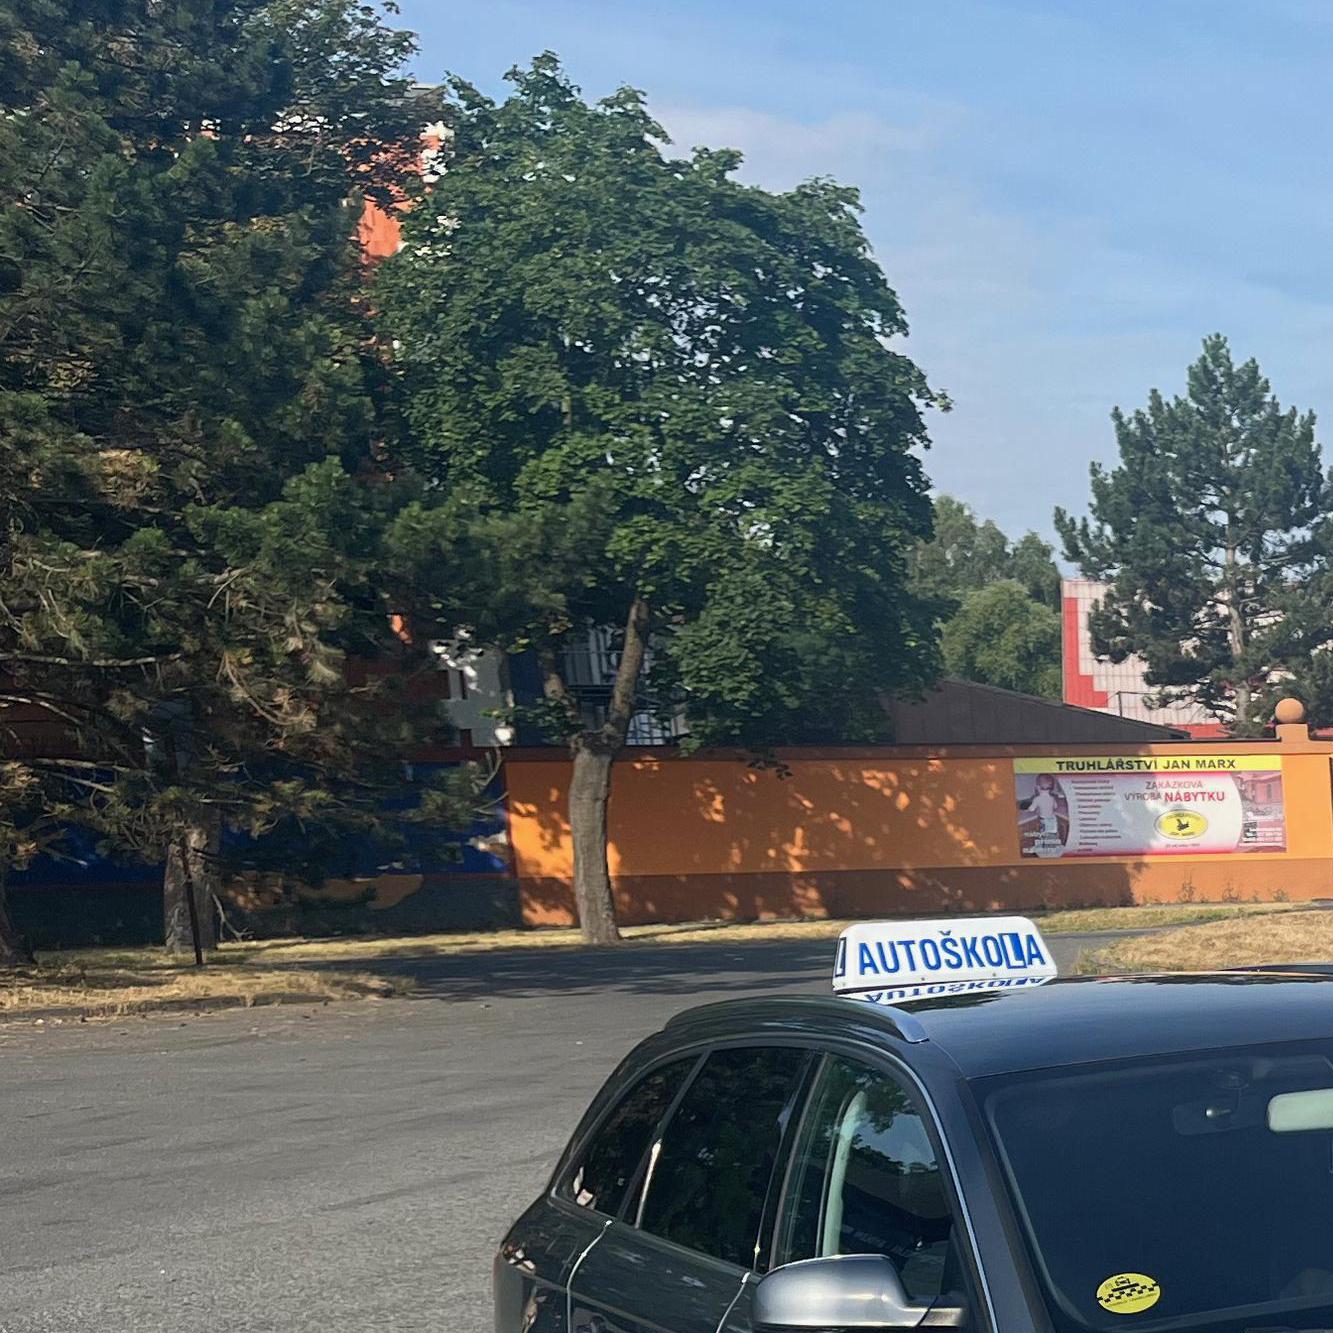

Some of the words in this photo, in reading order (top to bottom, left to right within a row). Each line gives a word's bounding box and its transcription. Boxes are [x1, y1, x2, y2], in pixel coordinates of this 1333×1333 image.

[1056, 757, 1158, 771] TRUHLÁŘSTVÍ
[1163, 759, 1190, 769] JAN
[1195, 759, 1236, 769] MARX
[1145, 780, 1204, 790] ZAKÁZKOVÁ
[1164, 791, 1225, 802] NÁBYTKU
[858, 930, 1046, 976] AUTOŠKOLA
